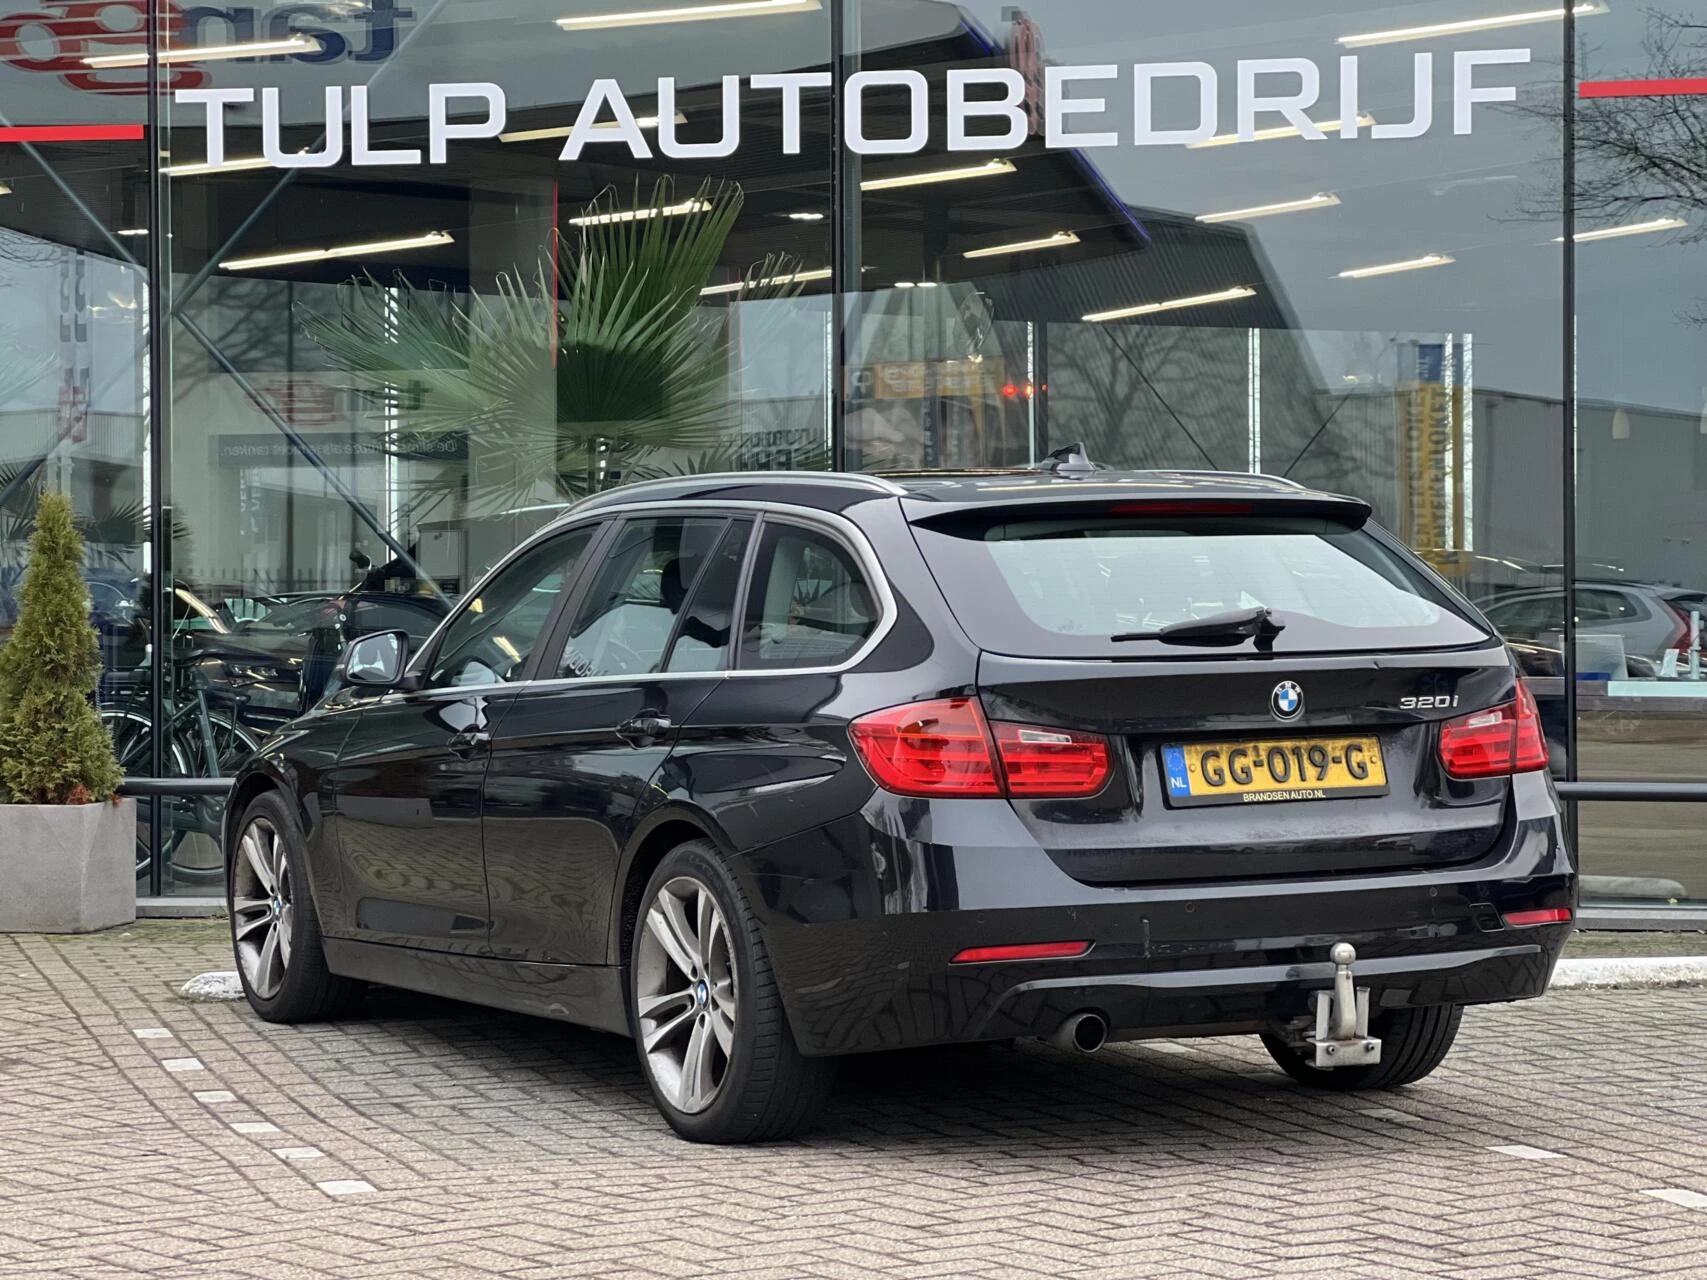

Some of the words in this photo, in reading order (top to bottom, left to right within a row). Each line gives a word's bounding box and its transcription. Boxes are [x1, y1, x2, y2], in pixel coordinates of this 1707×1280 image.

[174, 82, 507, 169] TULP
[559, 48, 1531, 161] AUTOBEDRIJF
[1399, 694, 1459, 710] 320i
[1171, 777, 1187, 790] NL
[1200, 742, 1369, 787] GG-019-G
